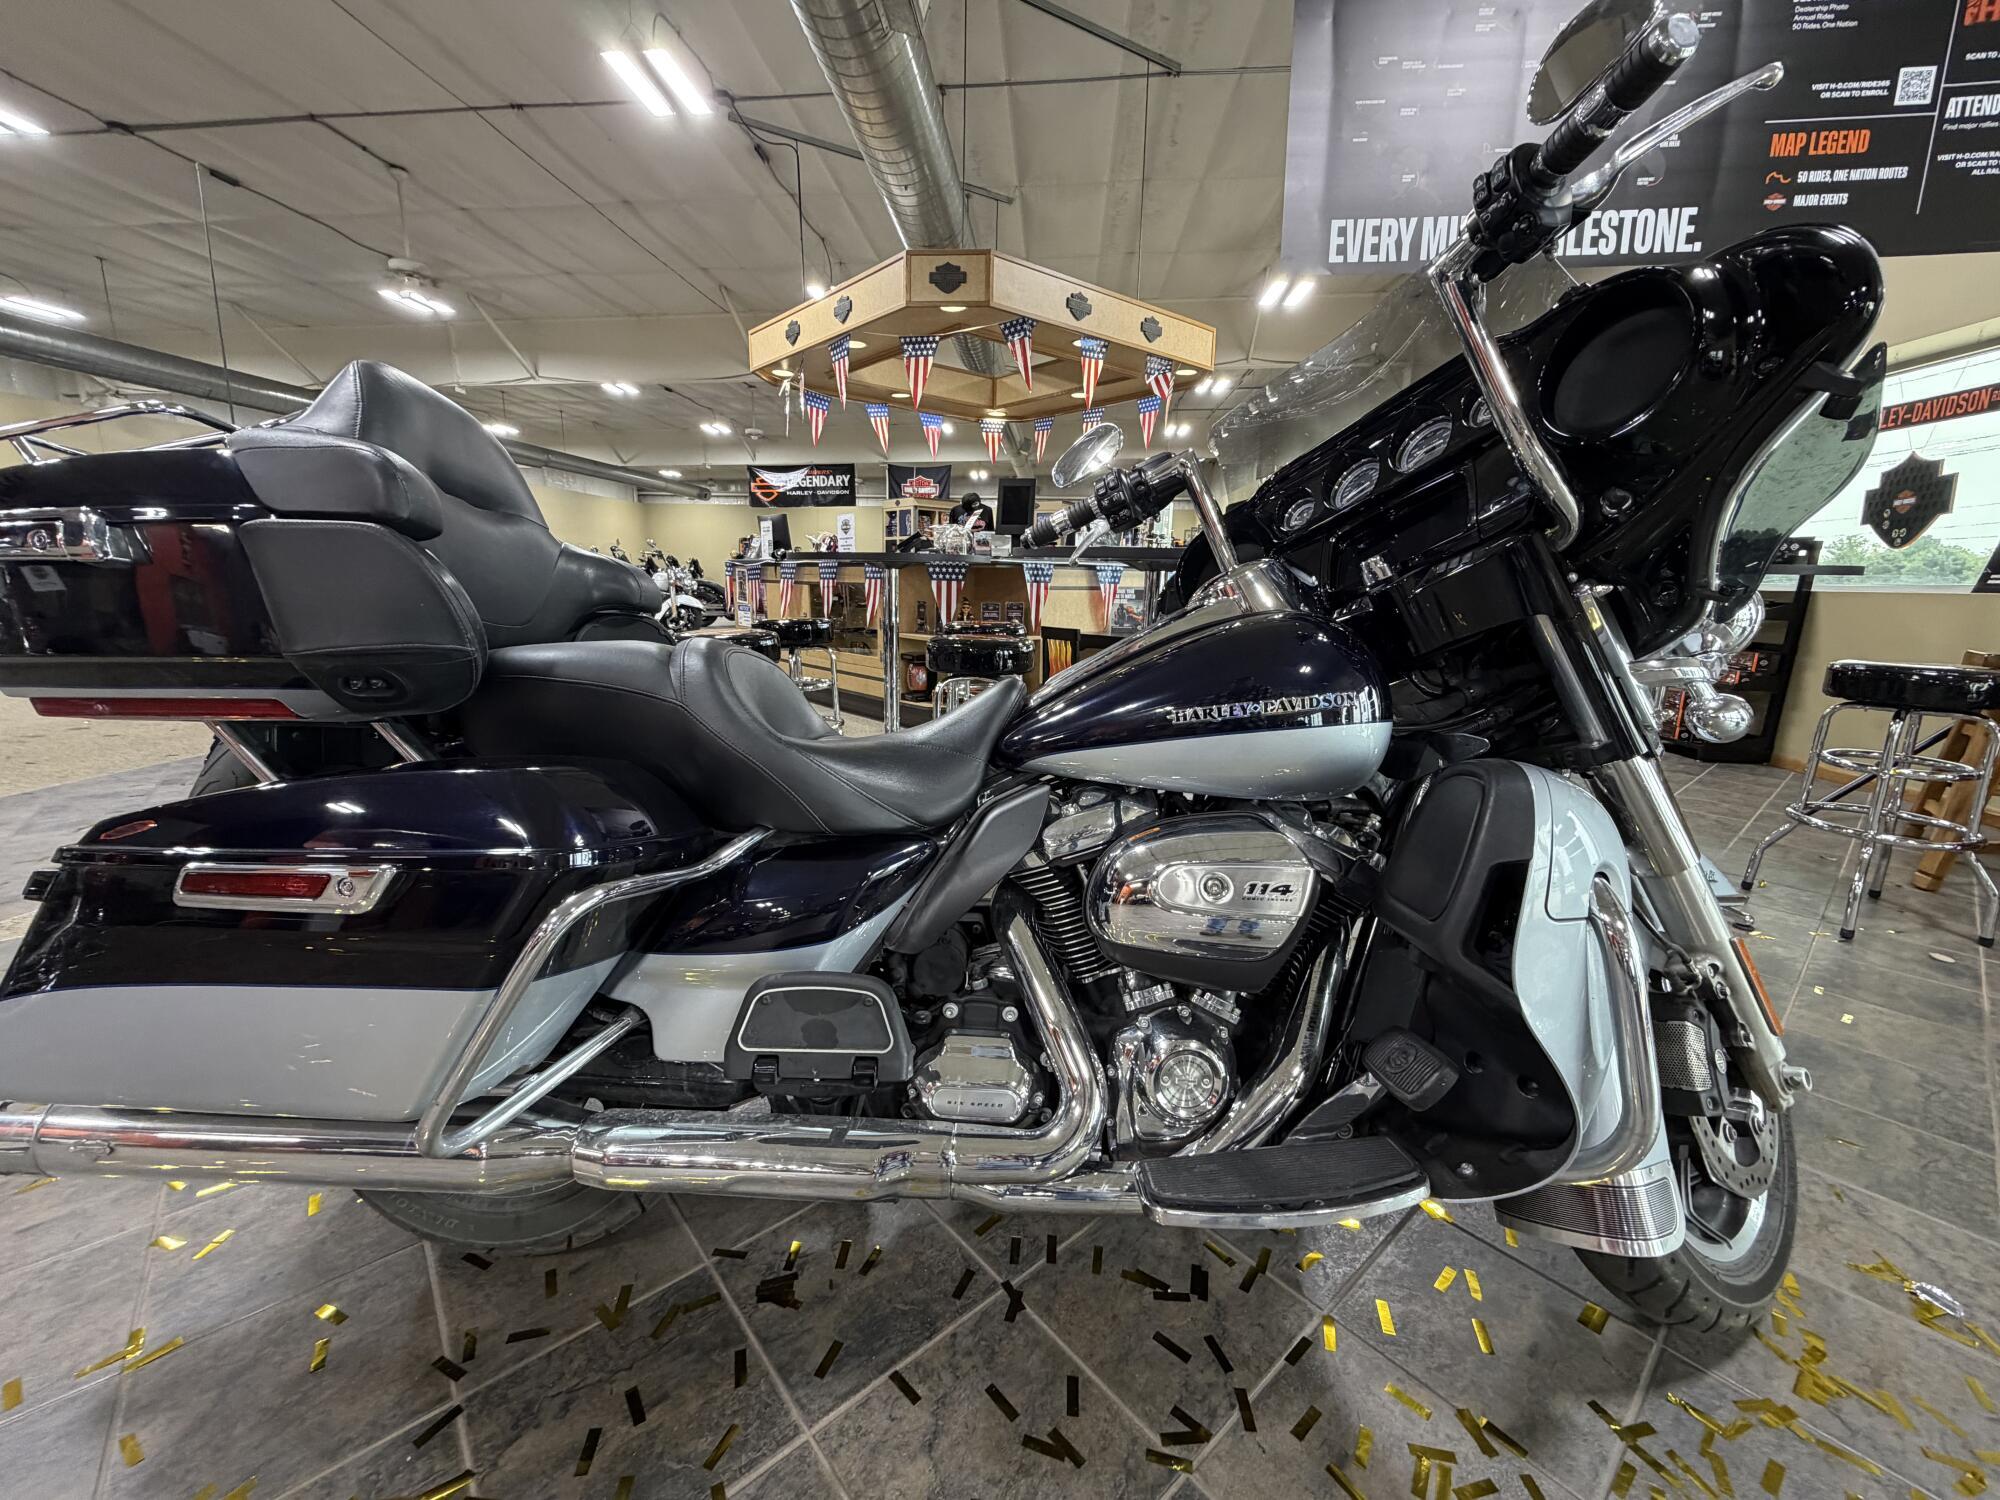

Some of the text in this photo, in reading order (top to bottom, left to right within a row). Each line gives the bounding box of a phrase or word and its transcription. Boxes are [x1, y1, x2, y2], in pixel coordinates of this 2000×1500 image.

[1792, 23, 1802, 31] 50
[1822, 21, 1836, 29] One
[1837, 20, 1859, 28] Nation
[1965, 51, 1998, 61] SCAN TO
[1811, 83, 1830, 91] VISIT
[1861, 89, 1889, 97] ENROLL
[1944, 94, 2000, 119] ATTEND
[1769, 129, 1871, 157] MAP LEGEND
[1937, 153, 1956, 162] VISIT
[1955, 161, 1967, 169] OR
[1967, 160, 1988, 168] SCAN
[1797, 166, 1909, 183] 50 RIDES, ONE NATION ROUTES
[1971, 168, 1985, 176] ALL
[1793, 195, 1820, 207] MAJOR
[1819, 193, 1849, 206] EVENTS
[1328, 216, 1418, 263] EVERY
[1167, 691, 1359, 723] HARLEY DAVIDSON
[1243, 880, 1296, 897] 114
